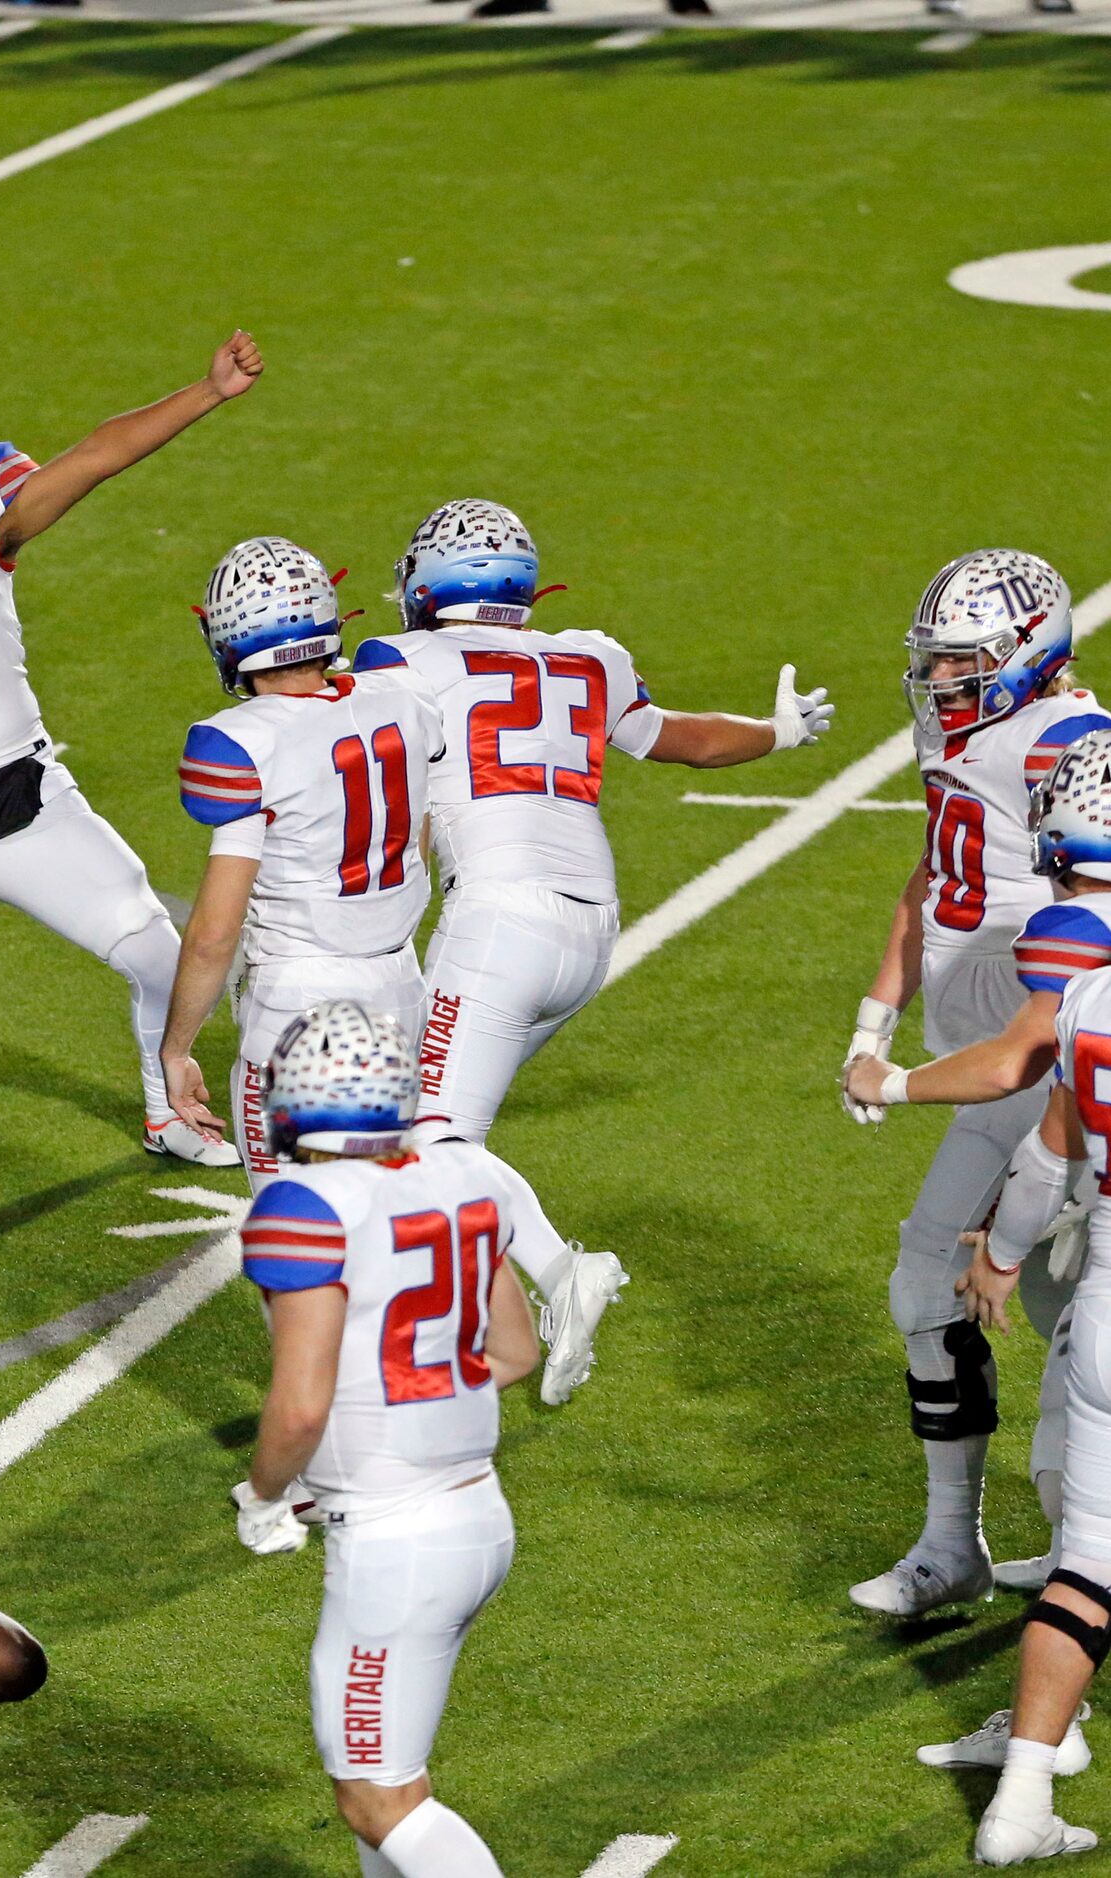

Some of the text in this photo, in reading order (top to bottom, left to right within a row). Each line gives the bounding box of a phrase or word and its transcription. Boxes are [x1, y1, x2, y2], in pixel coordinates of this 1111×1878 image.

[273, 639, 327, 664] HERITAGE
[984, 575, 1039, 620] 70
[461, 650, 607, 806] 23
[332, 722, 411, 897] 11
[379, 1197, 500, 1406] 20
[344, 1645, 387, 1764] HERITAGE
